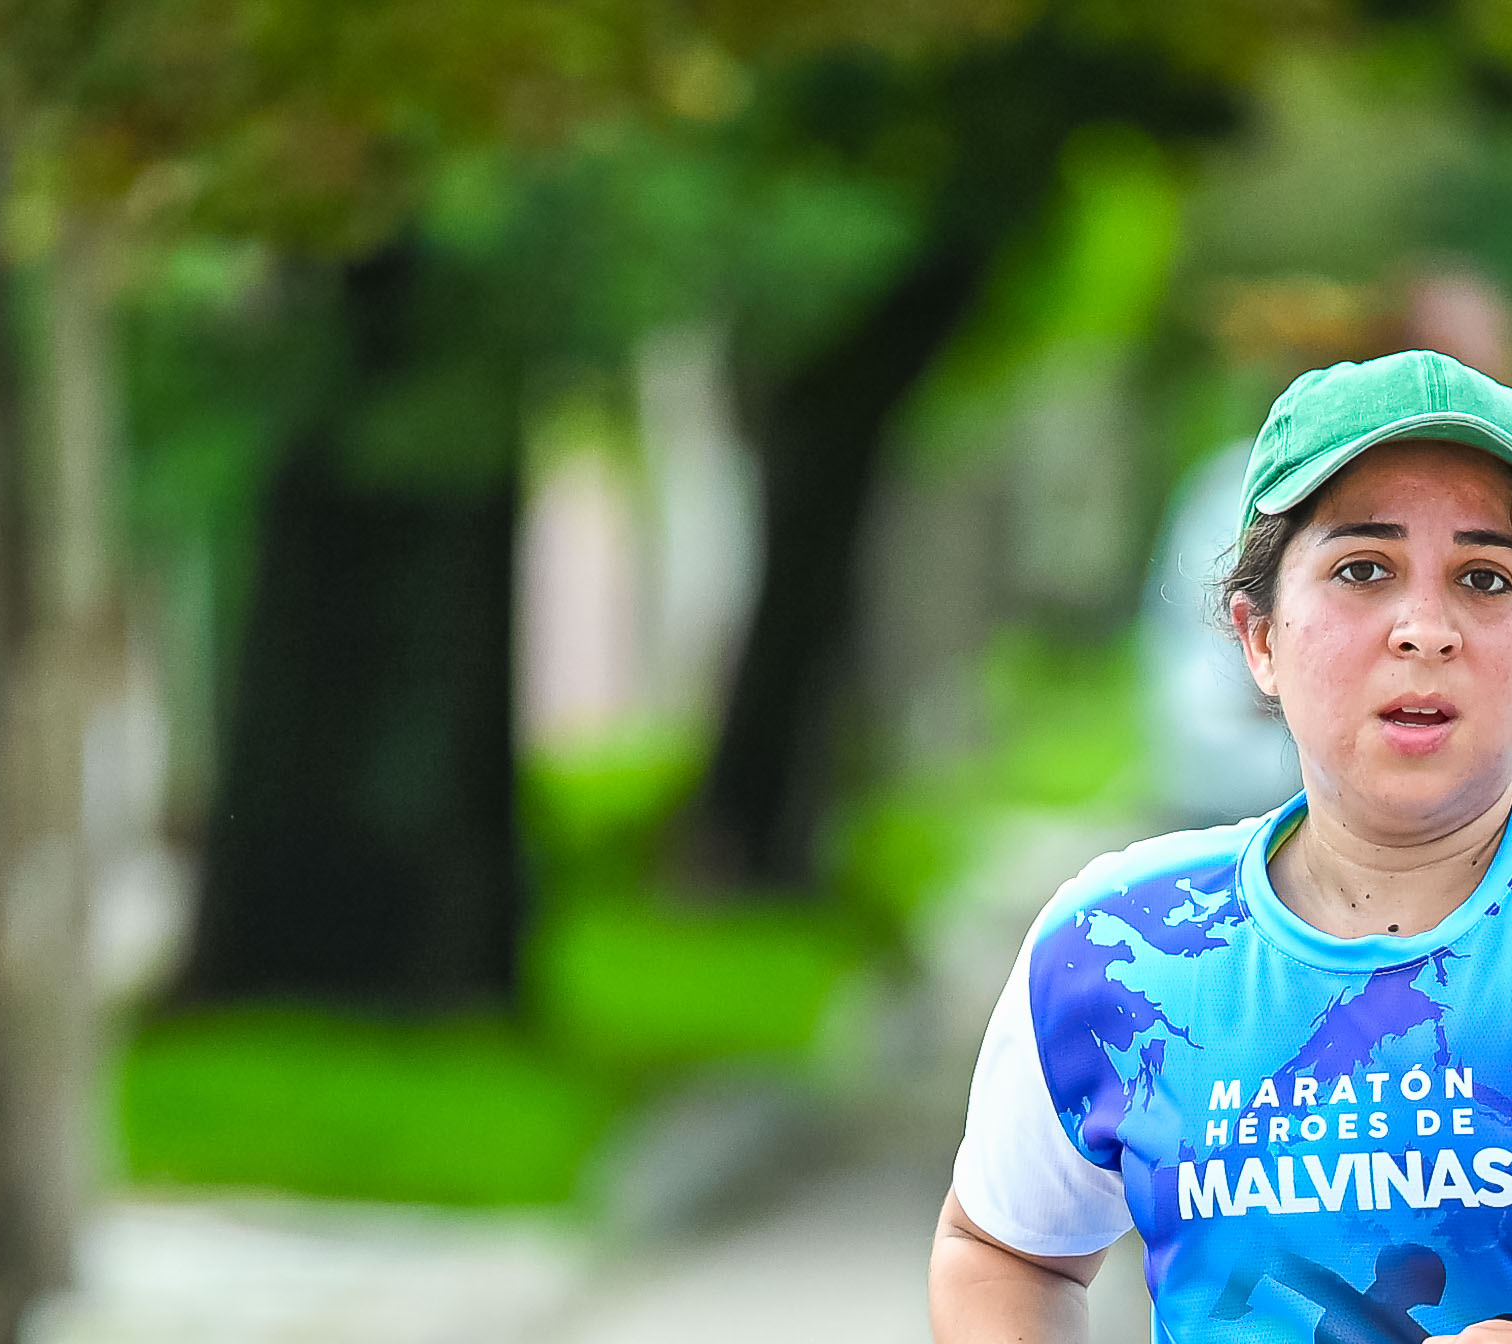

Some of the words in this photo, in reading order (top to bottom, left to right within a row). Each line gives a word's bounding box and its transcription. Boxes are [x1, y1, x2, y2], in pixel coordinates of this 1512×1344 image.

[1208, 1064, 1475, 1111] MARATÓN
[1204, 1109, 1389, 1146] HÉROES
[1416, 1107, 1475, 1136] DE
